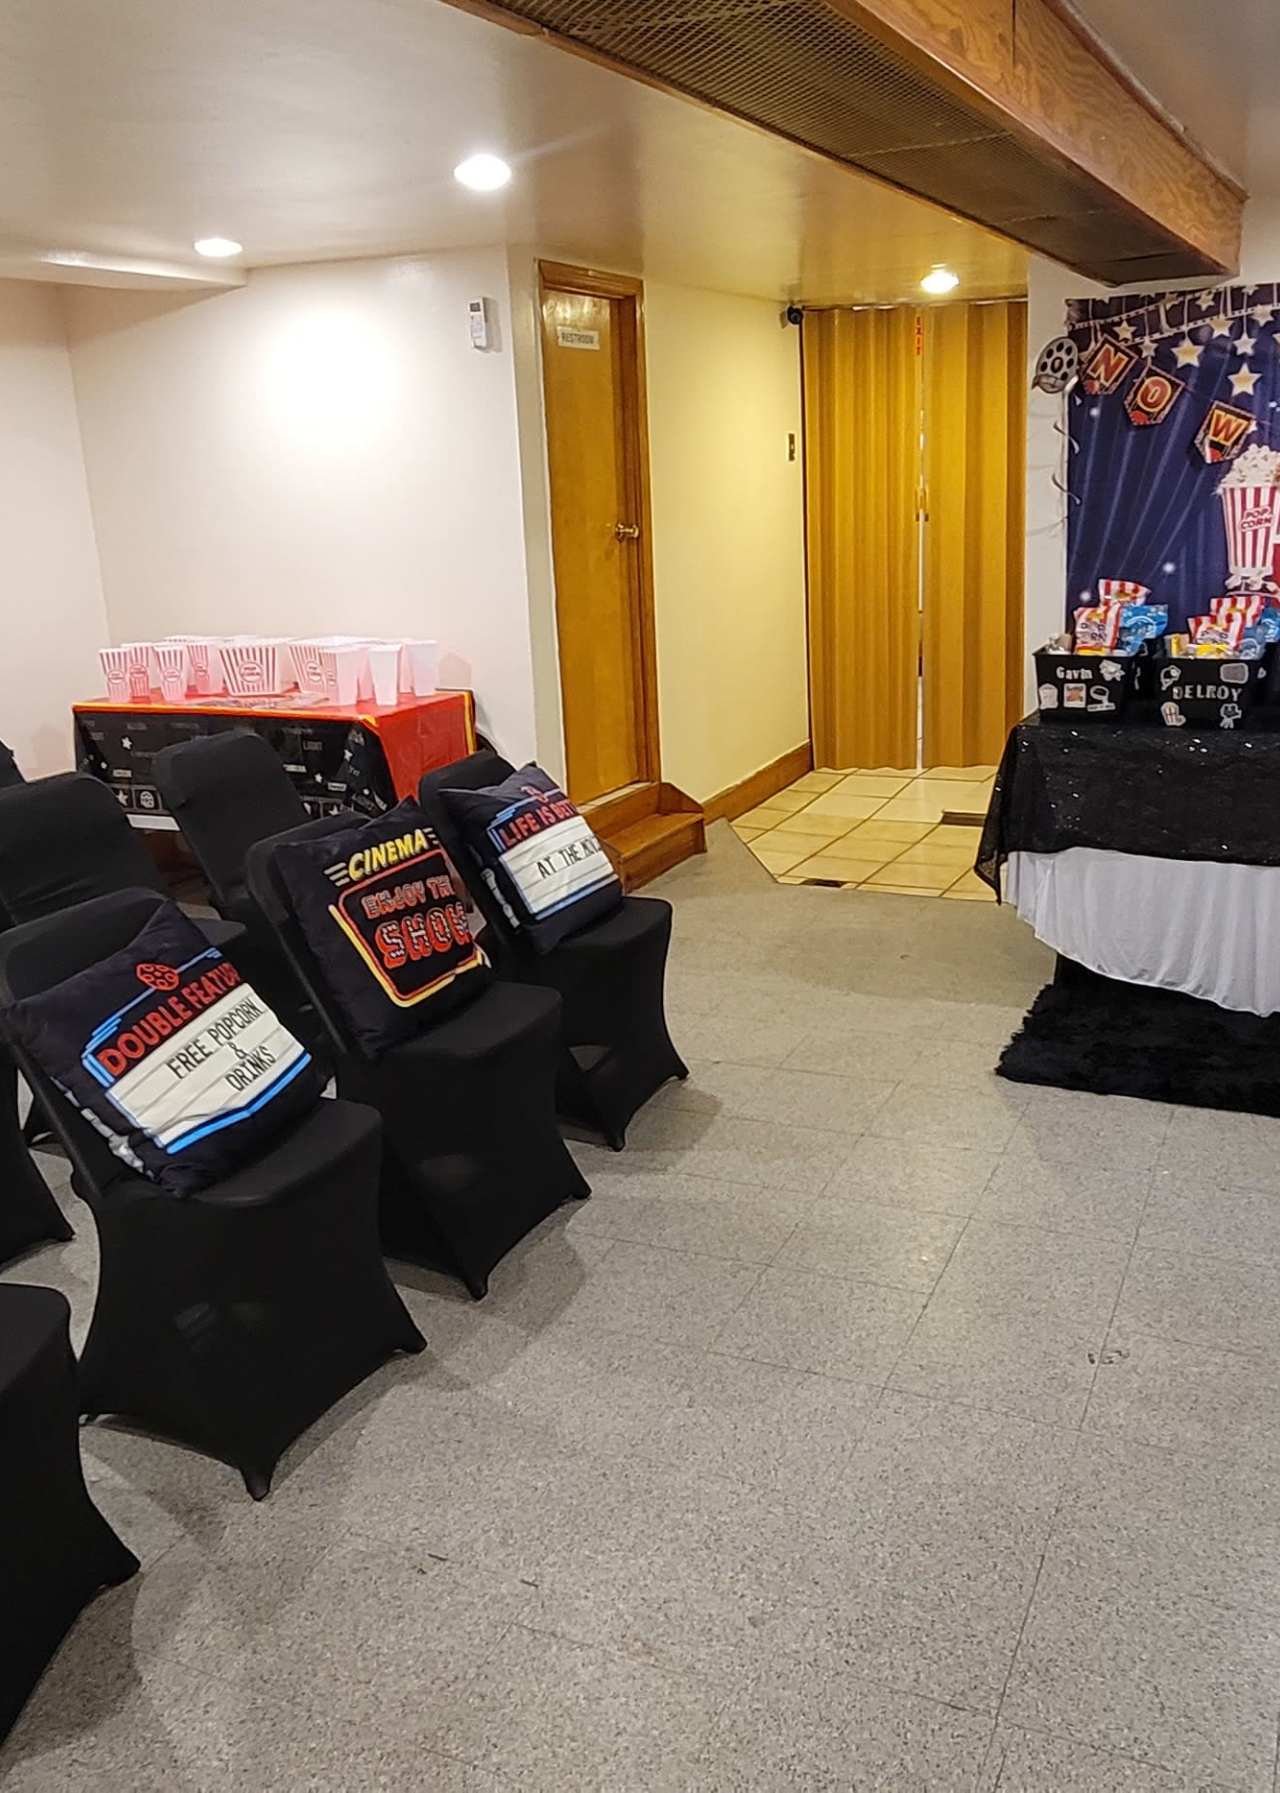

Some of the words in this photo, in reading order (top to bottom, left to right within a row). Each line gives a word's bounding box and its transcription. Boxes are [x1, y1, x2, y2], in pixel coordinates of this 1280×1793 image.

[1085, 344, 1250, 447] NOW
[1056, 666, 1093, 680] Gavin
[1172, 684, 1243, 701] DELROY
[499, 813, 540, 847] LIFE
[536, 806, 557, 825] IS
[348, 829, 429, 881] CINEMA
[536, 856, 557, 879] AT
[559, 844, 582, 866] THE
[361, 880, 426, 919] ENJOY
[96, 996, 193, 1076] DOUBLE
[166, 1039, 214, 1080] FREE
[207, 997, 265, 1047] POPCORN
[227, 1041, 249, 1060] &
[225, 1045, 277, 1091] DRINKS
